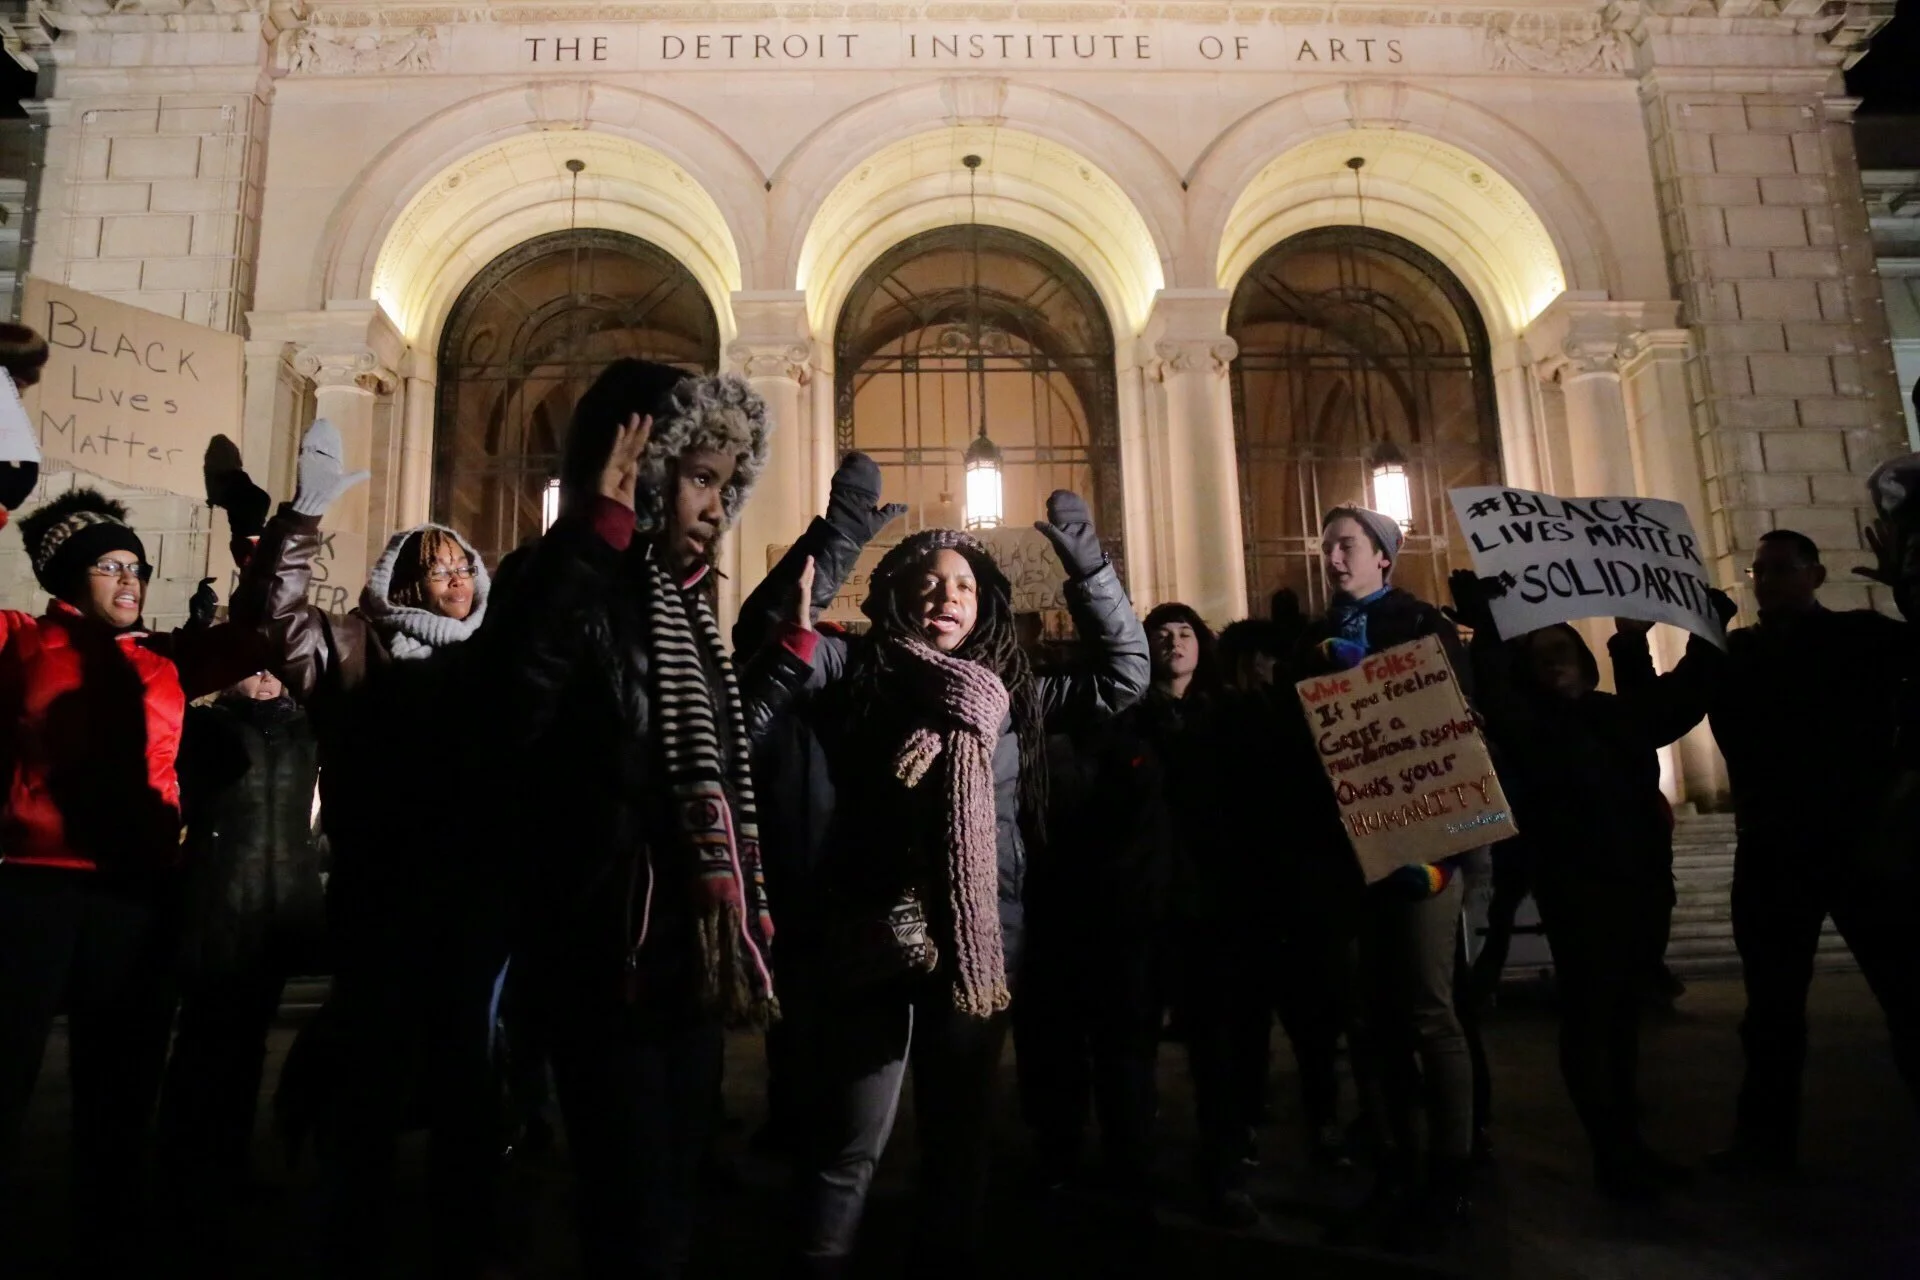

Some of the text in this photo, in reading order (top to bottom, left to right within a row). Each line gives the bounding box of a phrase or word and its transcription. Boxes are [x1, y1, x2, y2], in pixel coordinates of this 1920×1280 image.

[525, 33, 1404, 63] THE DETROIT INSTITUTE OF ARTS
[48, 301, 199, 381] BLACK
[1466, 490, 1670, 532] #BLACK
[1470, 520, 1702, 566] LIVES MATTER
[1351, 693, 1379, 720] you
[1400, 753, 1456, 794] your
